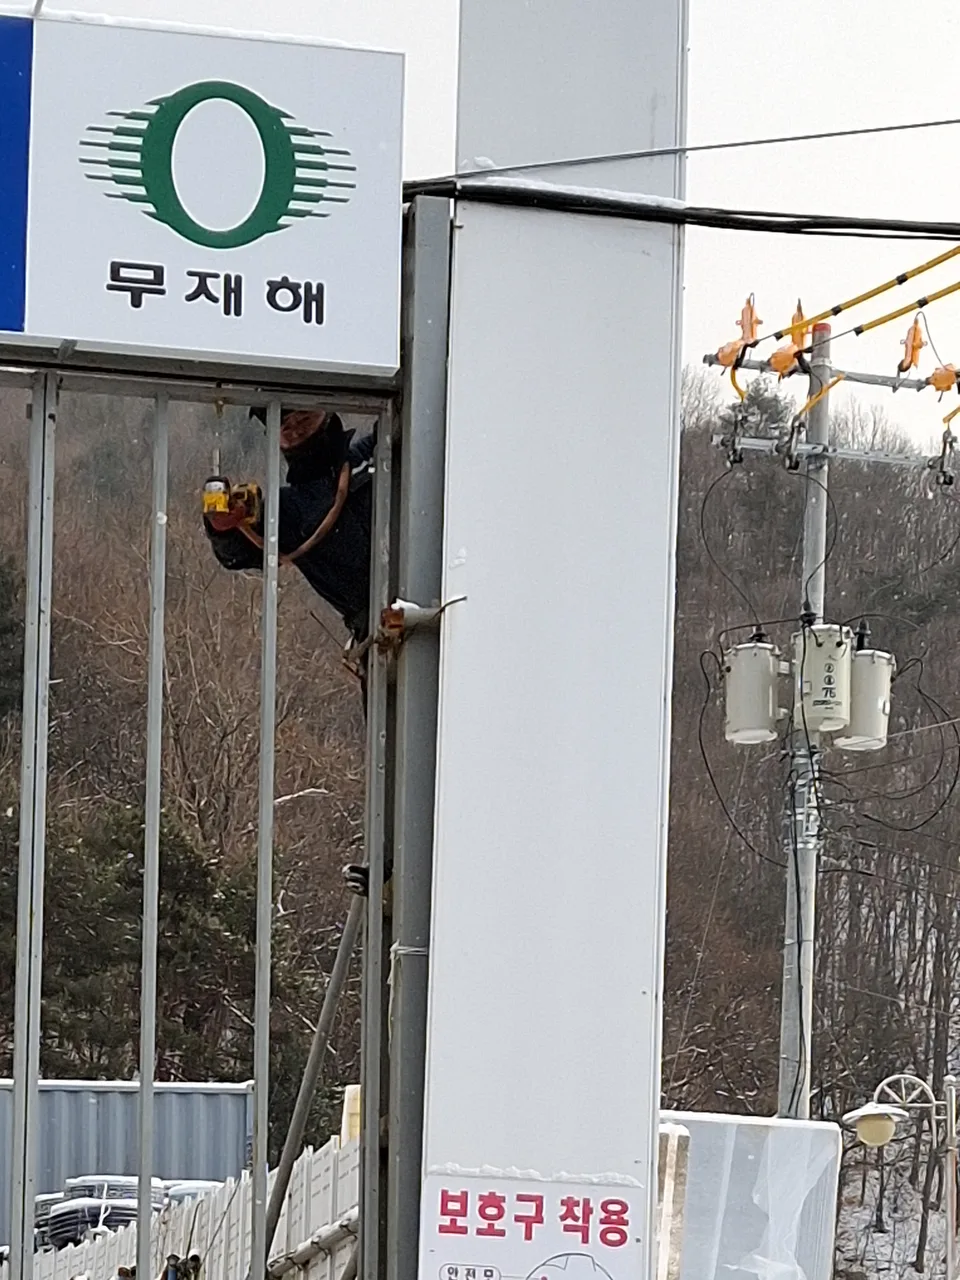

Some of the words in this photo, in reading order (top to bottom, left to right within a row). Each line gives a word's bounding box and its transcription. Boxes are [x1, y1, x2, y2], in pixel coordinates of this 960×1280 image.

[106, 260, 326, 325] 무재해
[438, 1189, 545, 1241] 보호구
[559, 1196, 630, 1248] 착용
